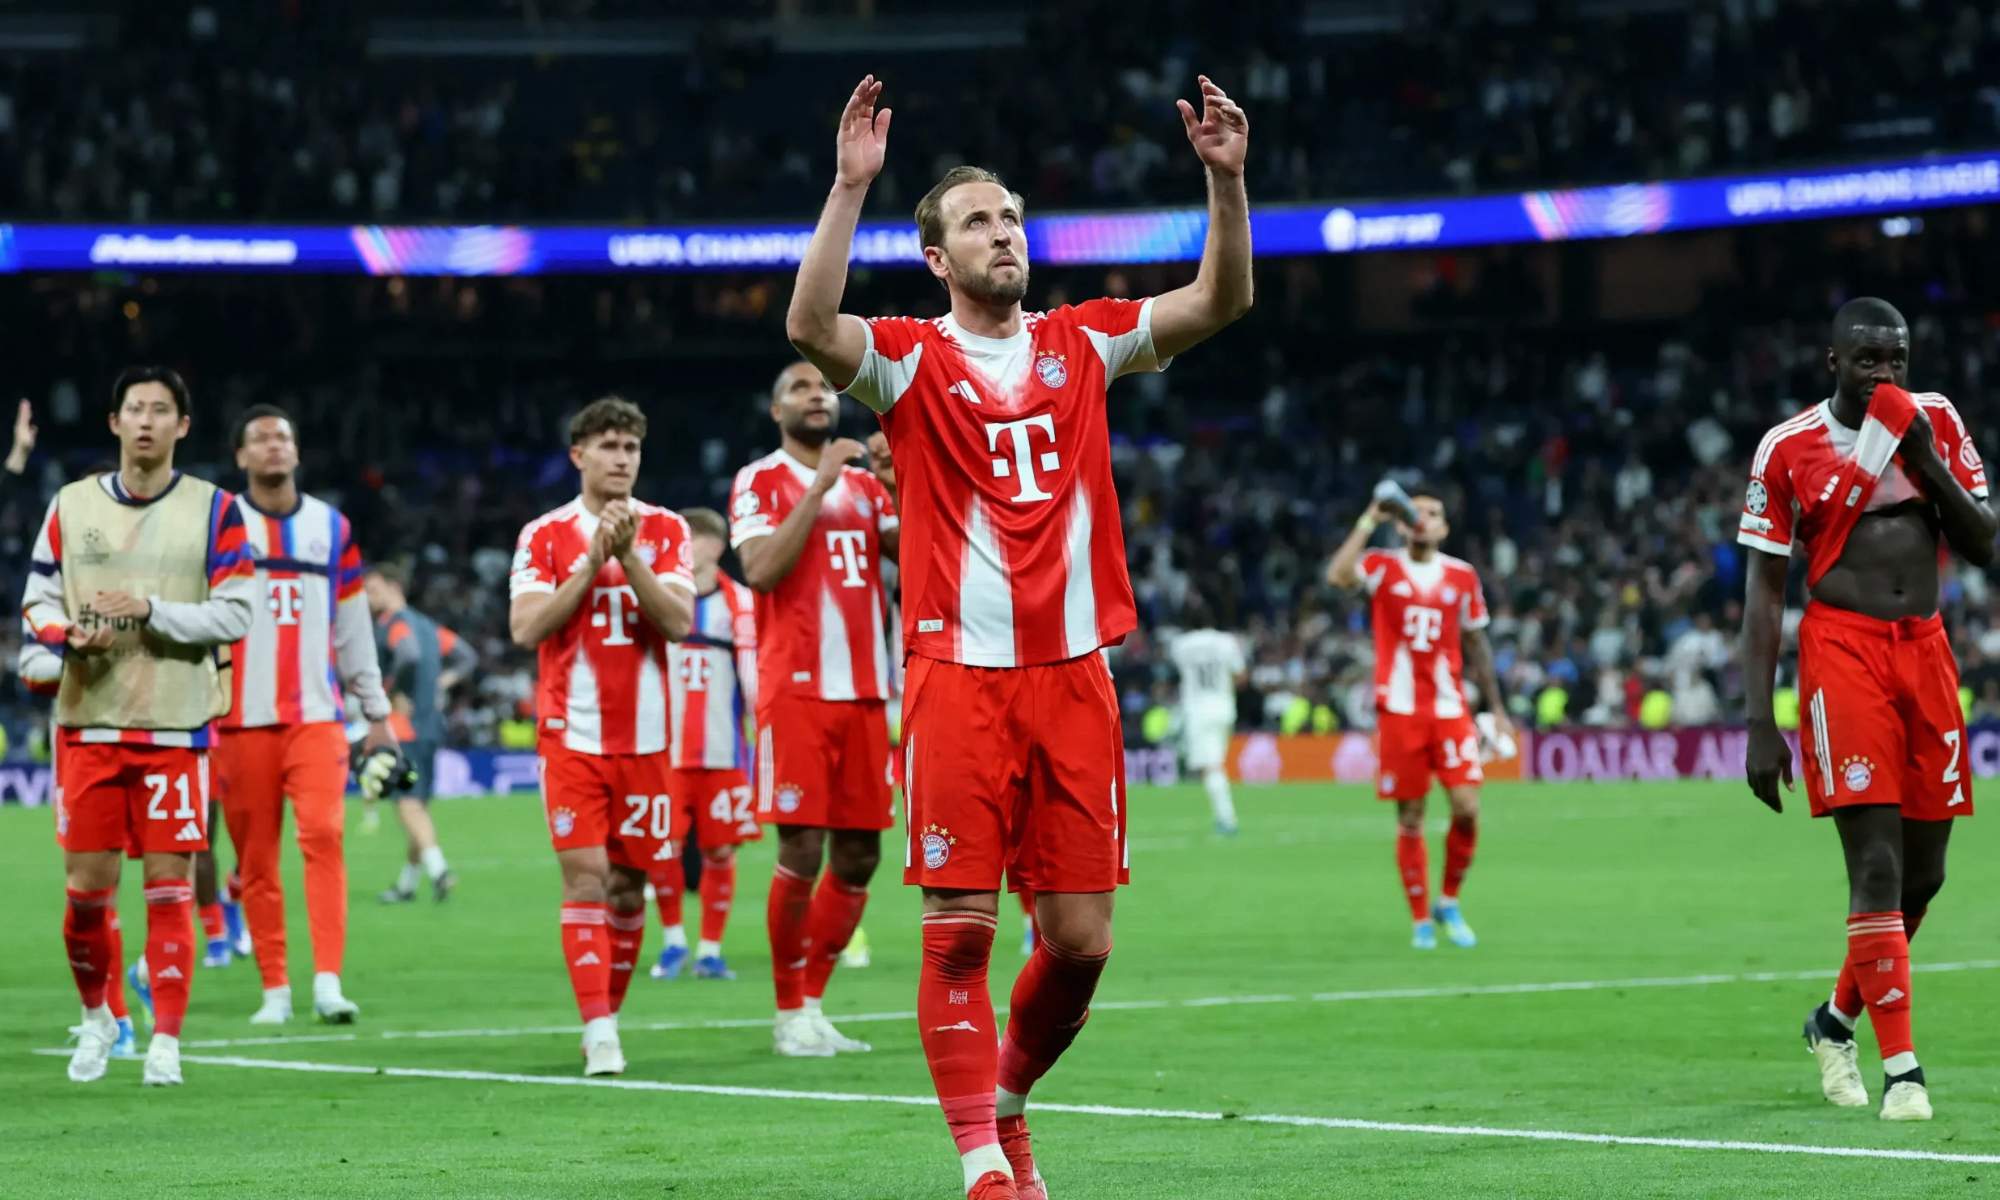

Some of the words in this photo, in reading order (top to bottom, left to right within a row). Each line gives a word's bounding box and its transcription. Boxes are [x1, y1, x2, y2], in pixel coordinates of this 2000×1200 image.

[984, 413, 1060, 503] T
[826, 531, 868, 588] T
[266, 579, 303, 625] T
[591, 586, 640, 646] T
[1403, 604, 1442, 652] T
[680, 651, 712, 691] T
[1443, 736, 1479, 769] 14
[1538, 733, 1678, 781] QATAR
[1942, 728, 1960, 783] 2
[144, 773, 196, 820] 21
[619, 794, 671, 839] 20
[709, 786, 755, 822] 42
